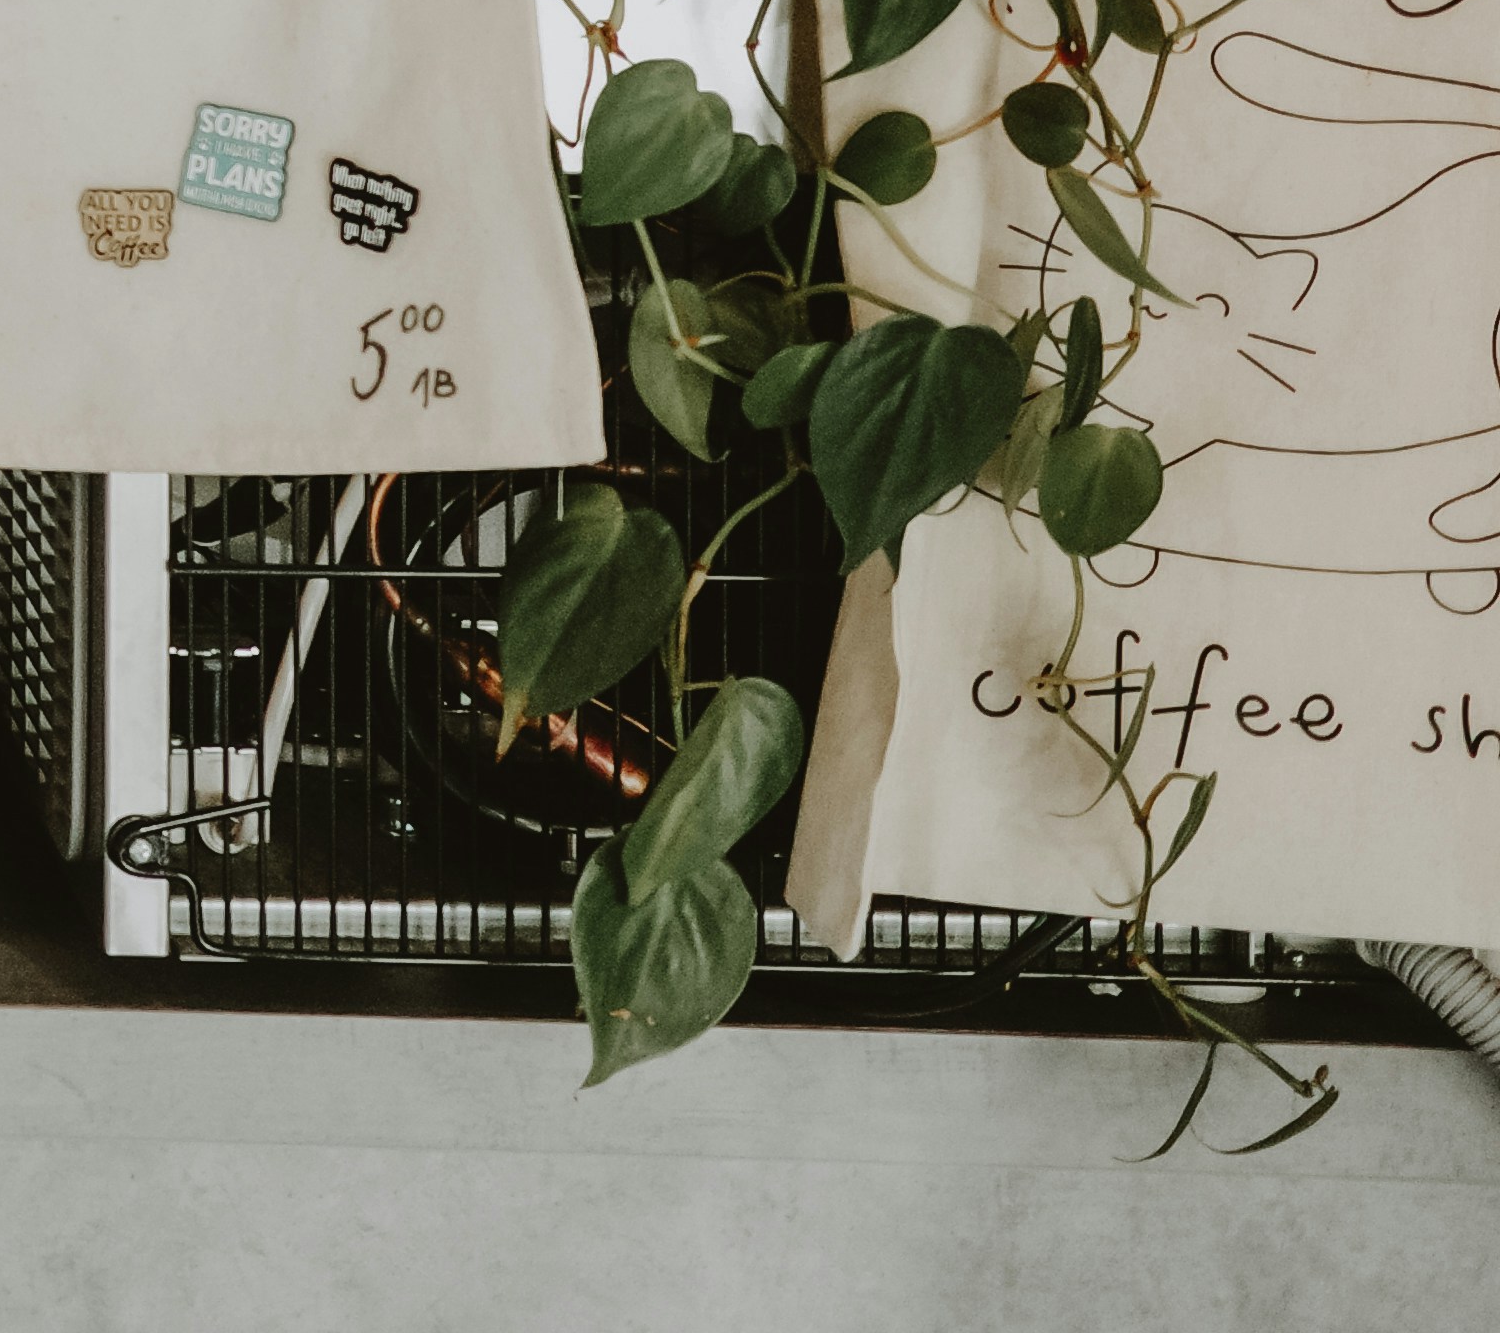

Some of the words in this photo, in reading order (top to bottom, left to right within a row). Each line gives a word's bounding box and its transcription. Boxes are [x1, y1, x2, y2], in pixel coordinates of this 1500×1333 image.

[200, 108, 287, 148] SORRY
[186, 153, 284, 199] PLANS
[126, 195, 167, 212] YOU
[88, 215, 142, 232] NEED
[148, 215, 165, 232] IS
[94, 229, 160, 262] Coffee
